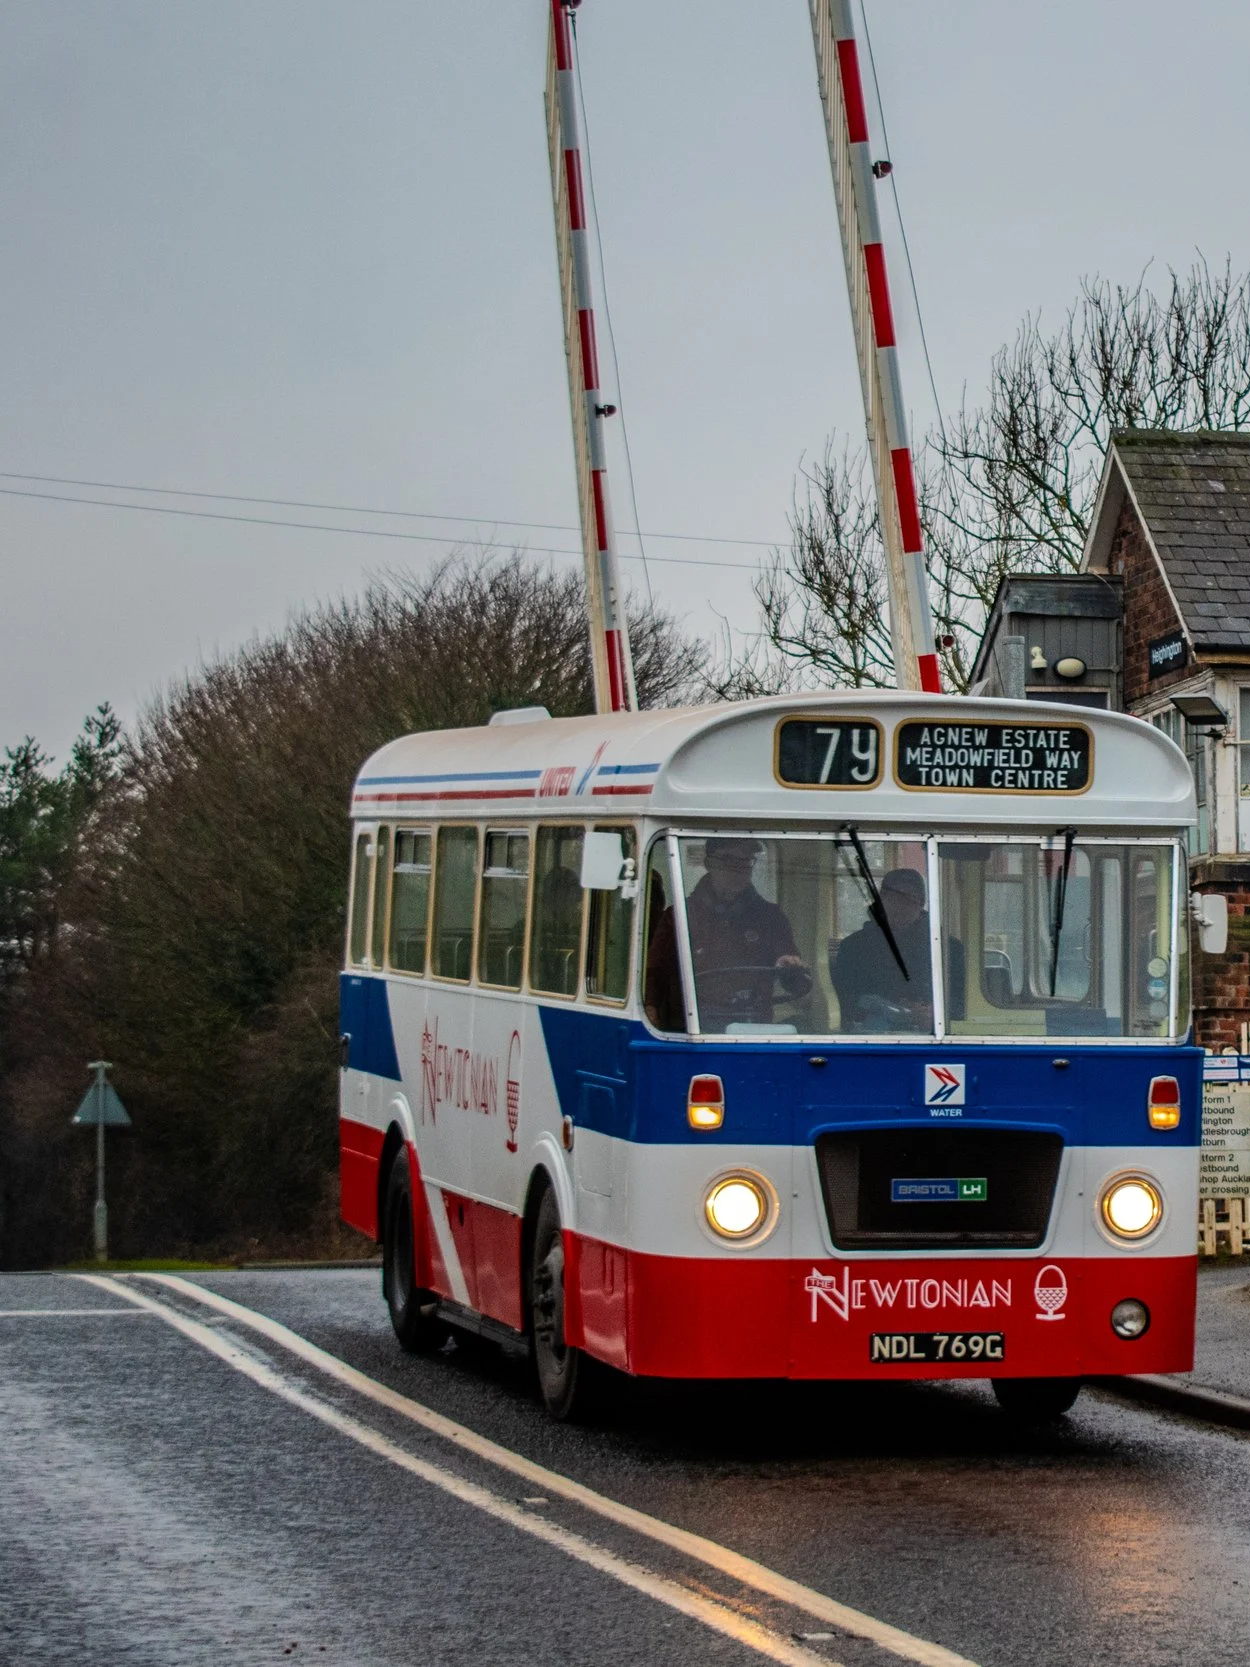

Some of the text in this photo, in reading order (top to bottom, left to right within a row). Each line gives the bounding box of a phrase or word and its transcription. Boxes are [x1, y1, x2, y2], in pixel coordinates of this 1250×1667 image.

[1152, 641, 1182, 664] Heighington
[920, 728, 1071, 748] AGNEW ESTATE
[906, 747, 1081, 769] MEADOWFIELD WAY
[918, 767, 1069, 788] TOWN CENTRE
[1203, 1095, 1225, 1104] form
[930, 1108, 963, 1117] WATER
[1203, 1106, 1235, 1114] tbound
[1202, 1117, 1233, 1126] lington
[1202, 1138, 1226, 1146] tburn
[1201, 1153, 1235, 1162] tform 2
[1200, 1164, 1239, 1173] stbound
[1200, 1174, 1219, 1184] hop
[898, 1184, 982, 1195] BRISTOL LH
[1211, 1185, 1250, 1195] crossing
[808, 1279, 833, 1289] THE
[872, 1334, 1003, 1360] NDL 769G
